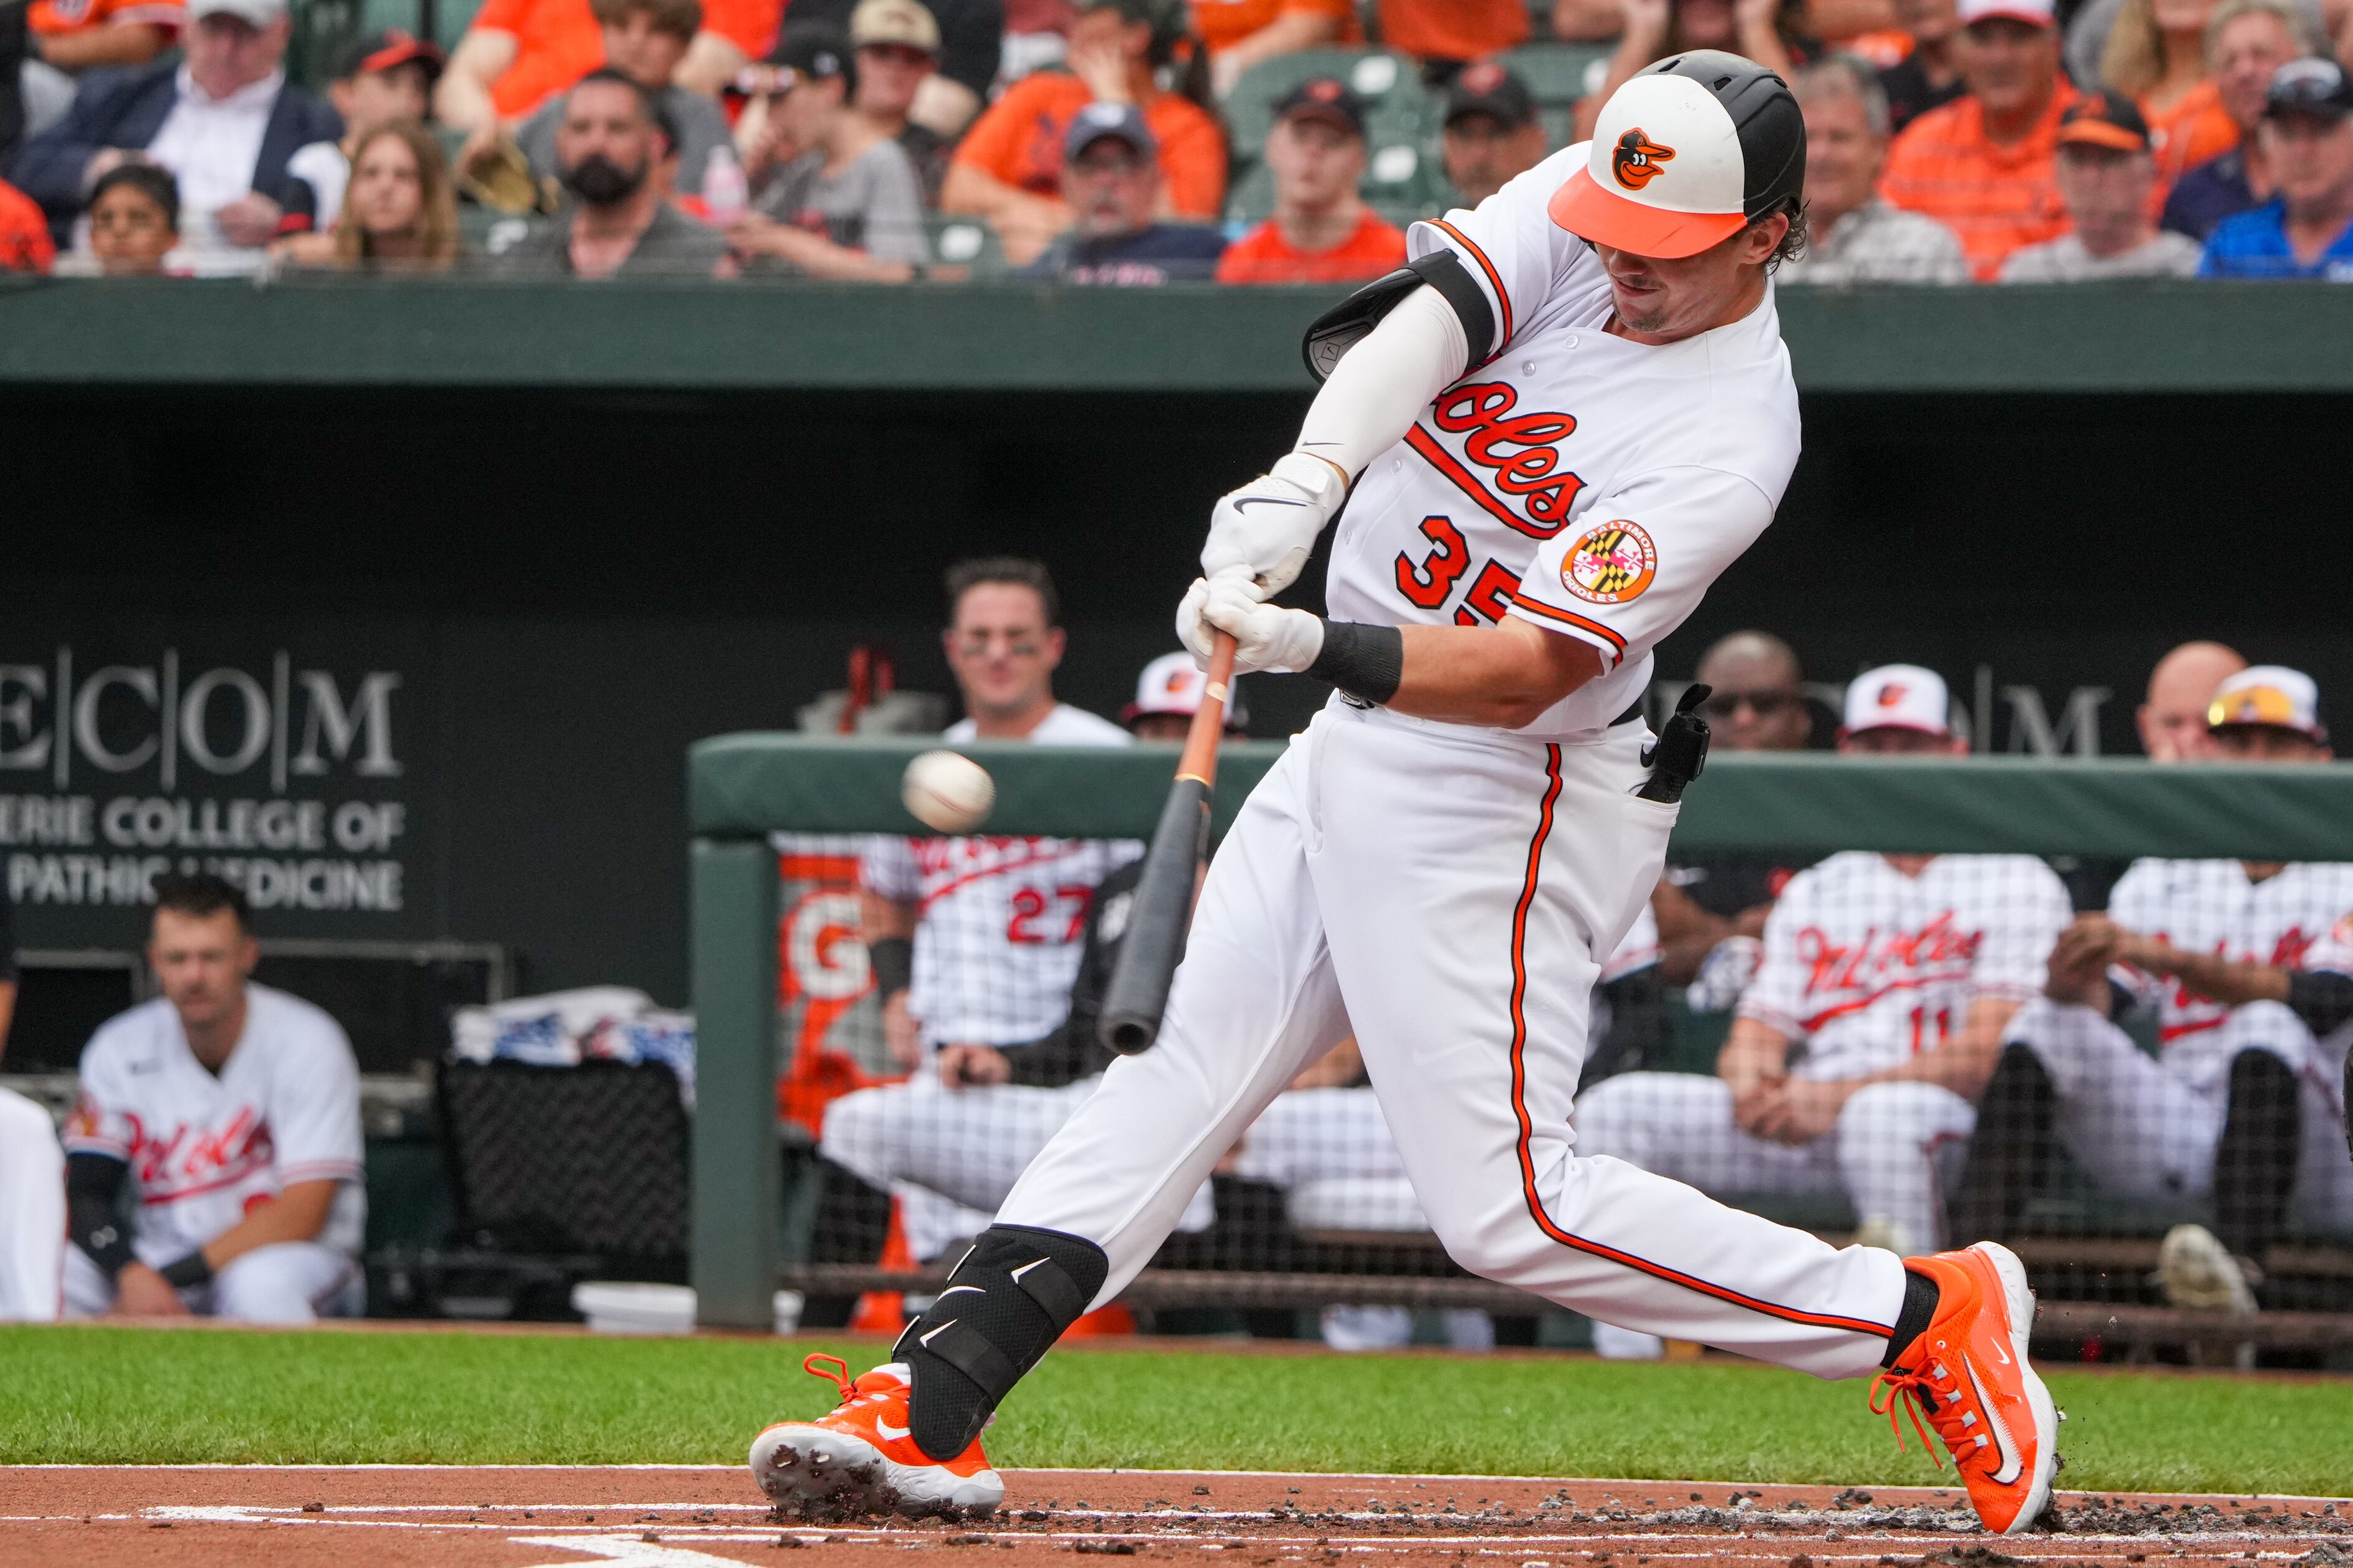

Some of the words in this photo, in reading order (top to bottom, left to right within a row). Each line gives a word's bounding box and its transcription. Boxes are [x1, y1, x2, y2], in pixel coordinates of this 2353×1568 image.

[1430, 381, 1588, 523] oles
[1586, 521, 1655, 571] BALTIMORE
[1563, 570, 1619, 602] ORIOLES
[0, 794, 94, 845] ERIE
[102, 796, 326, 851] COLLEGE
[332, 801, 406, 853] OF
[178, 855, 404, 911] DICINE
[1008, 887, 1094, 944] 27
[790, 892, 871, 998] G
